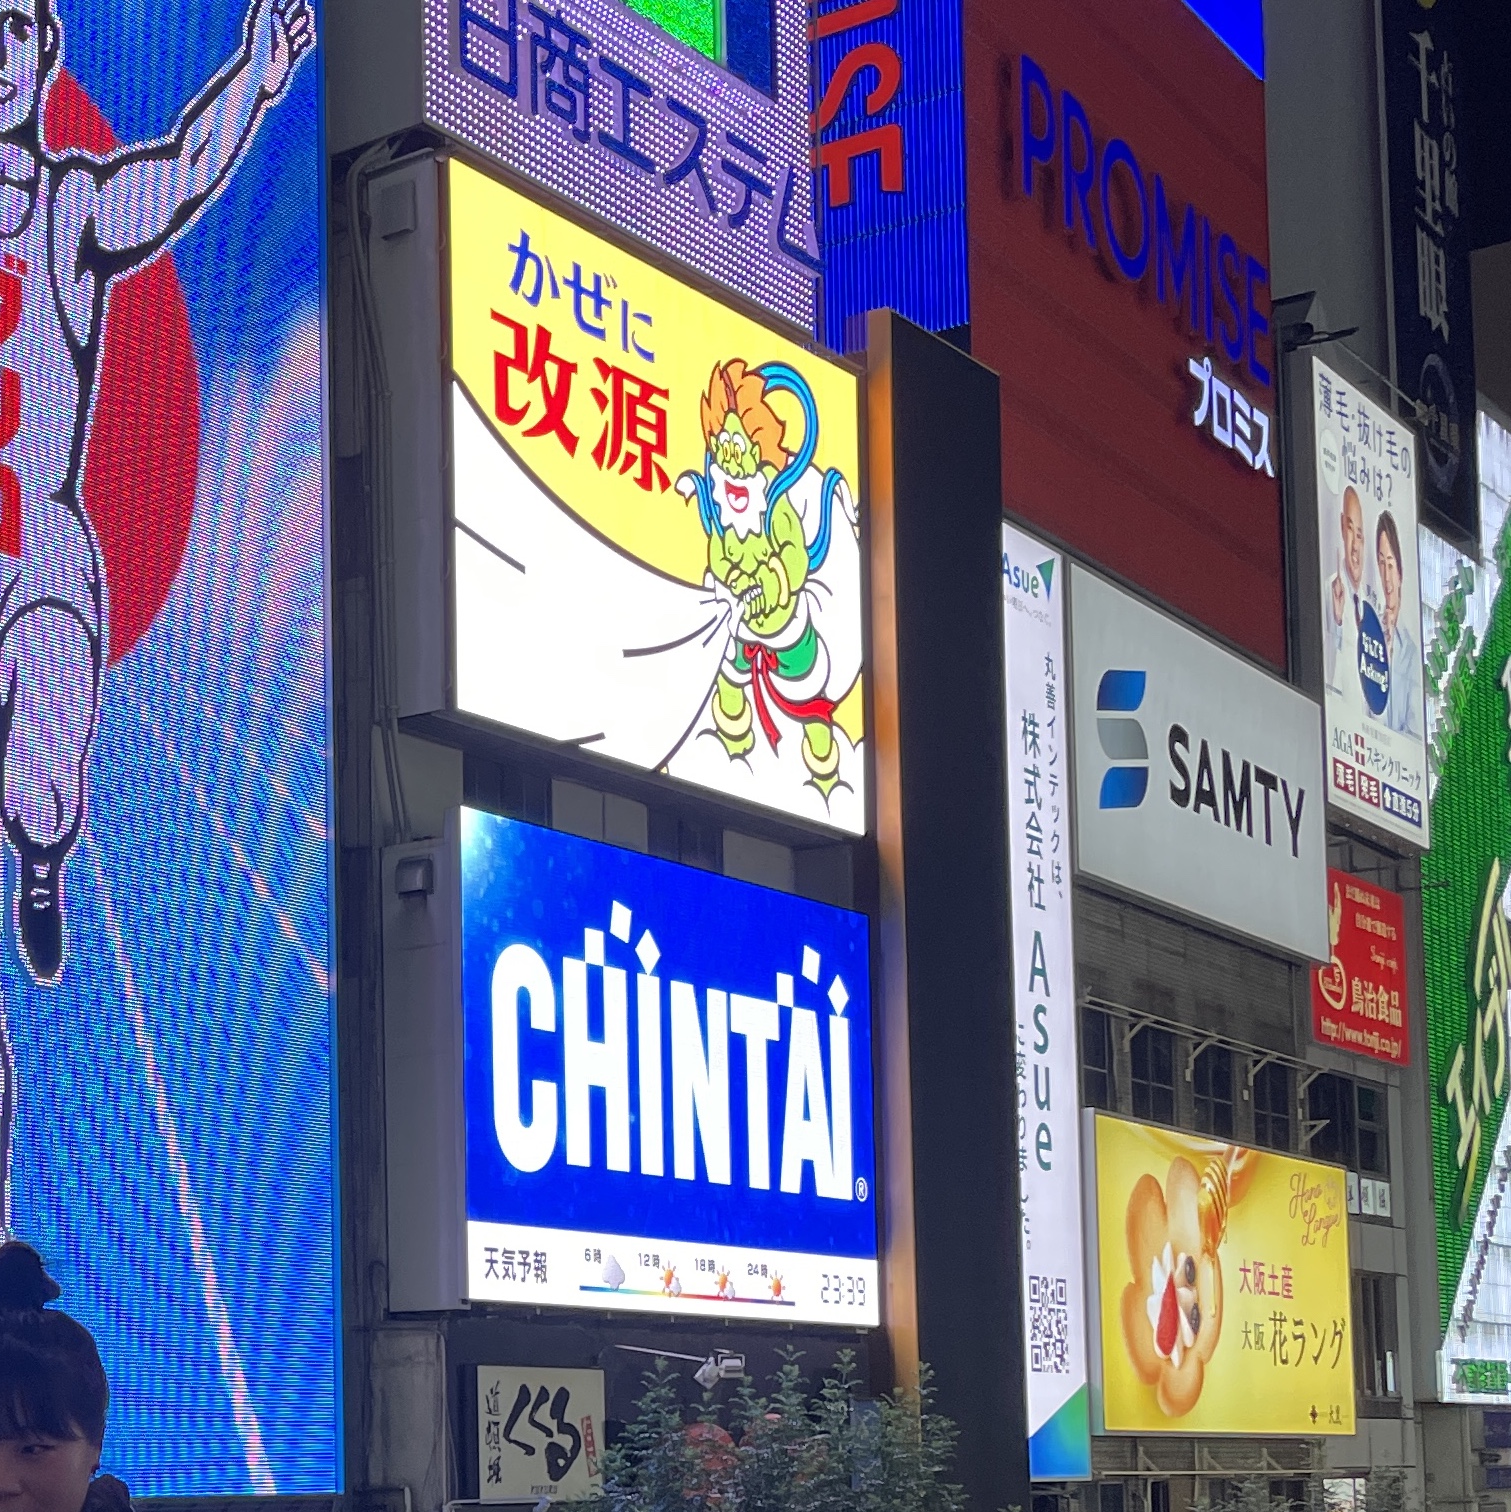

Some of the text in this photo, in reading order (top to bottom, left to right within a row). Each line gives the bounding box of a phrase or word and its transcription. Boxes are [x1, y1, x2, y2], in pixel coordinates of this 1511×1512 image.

[1020, 53, 1272, 388] PROMISE
[507, 228, 656, 363] かぜに
[489, 308, 672, 495] 改源
[1188, 355, 1275, 479] プロミス
[1021, 708, 1047, 912] 株式会社
[1167, 722, 1306, 859] SAMTY
[1331, 726, 1354, 760] AGA
[1366, 745, 1422, 792] スキンクリニック
[491, 899, 853, 1202] CHINTAI
[483, 1246, 549, 1285] 天気予報
[820, 1273, 867, 1307] 23:39
[1238, 1259, 1294, 1300] 大阪土産
[1240, 1309, 1347, 1370] 大阪 花ラング
[502, 1383, 582, 1483] くくる
